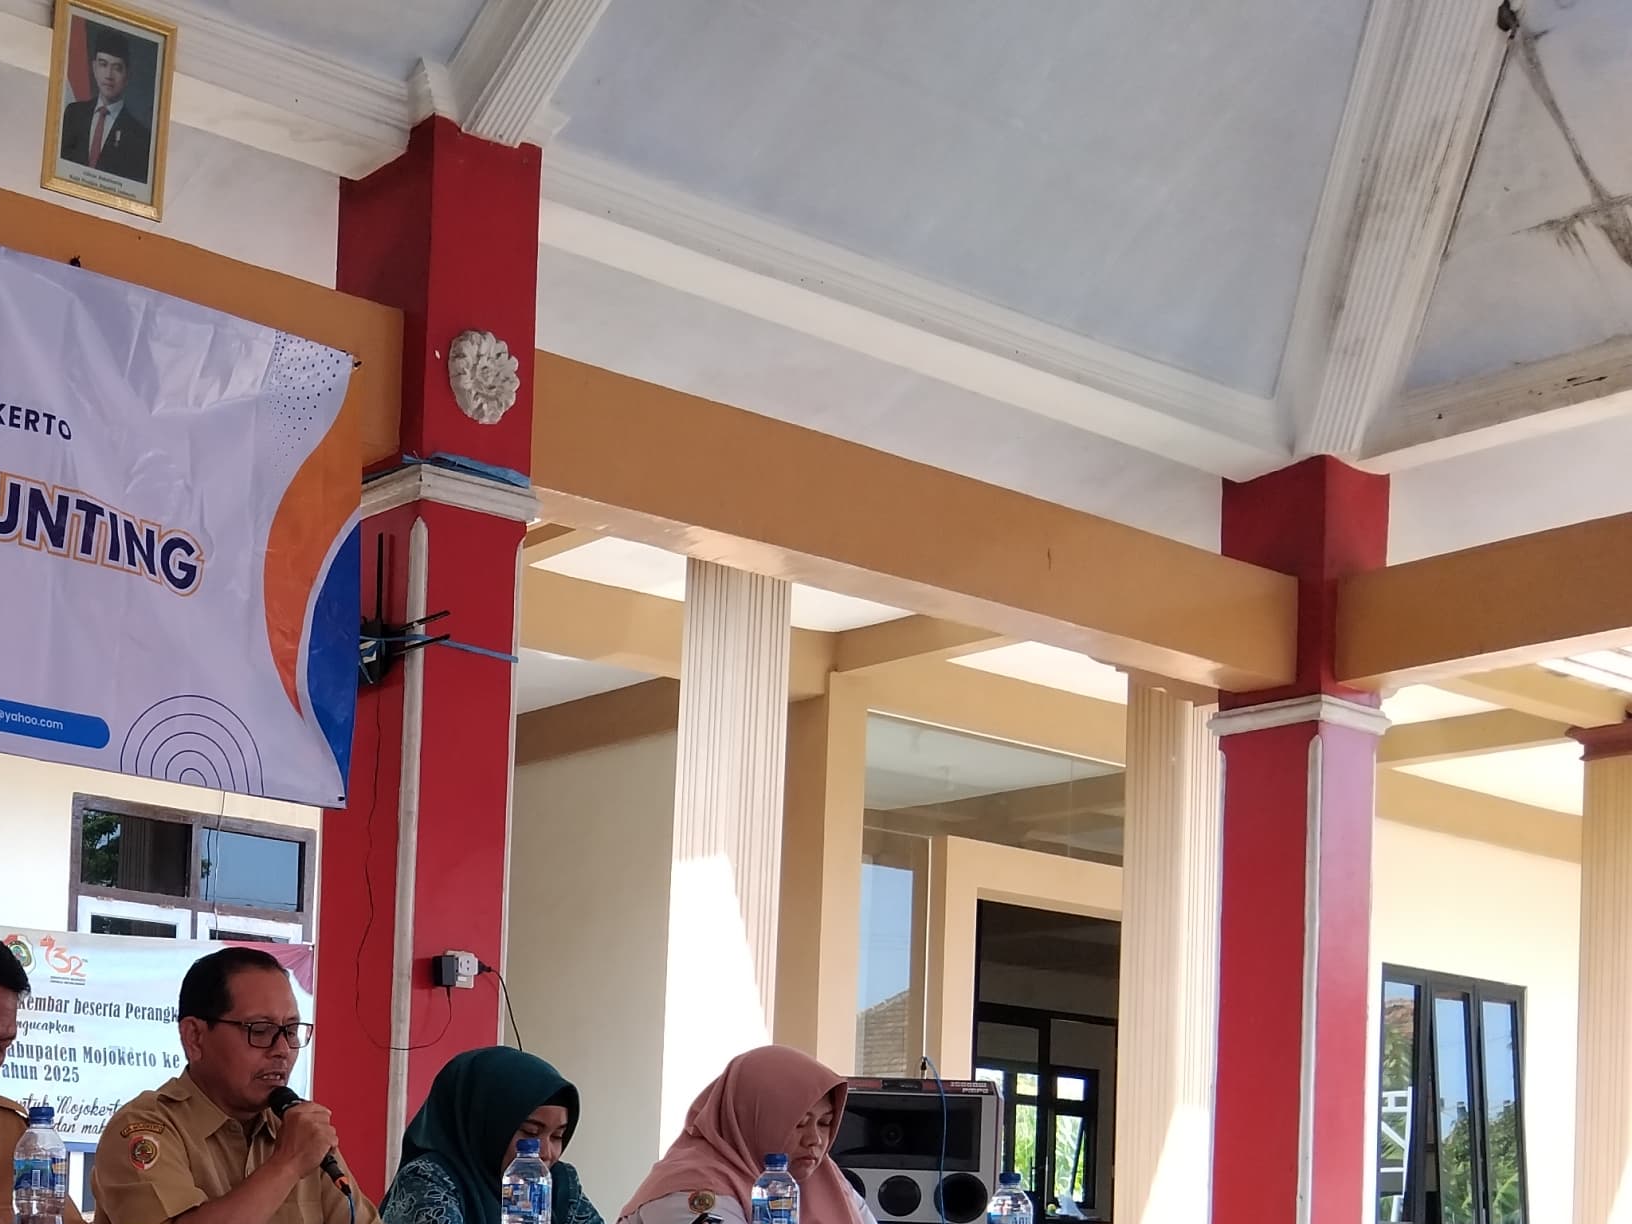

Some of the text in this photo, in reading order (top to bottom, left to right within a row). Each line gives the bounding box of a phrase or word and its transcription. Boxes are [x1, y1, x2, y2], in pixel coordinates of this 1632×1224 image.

[18, 995, 179, 1024] kembar beserta Perangk
[17, 1019, 75, 1036] ngucapkan
[7, 1041, 180, 1069] abupaten Mojokerto ke
[0, 1057, 80, 1083] ahun 2025
[56, 1095, 123, 1121] Mojokert
